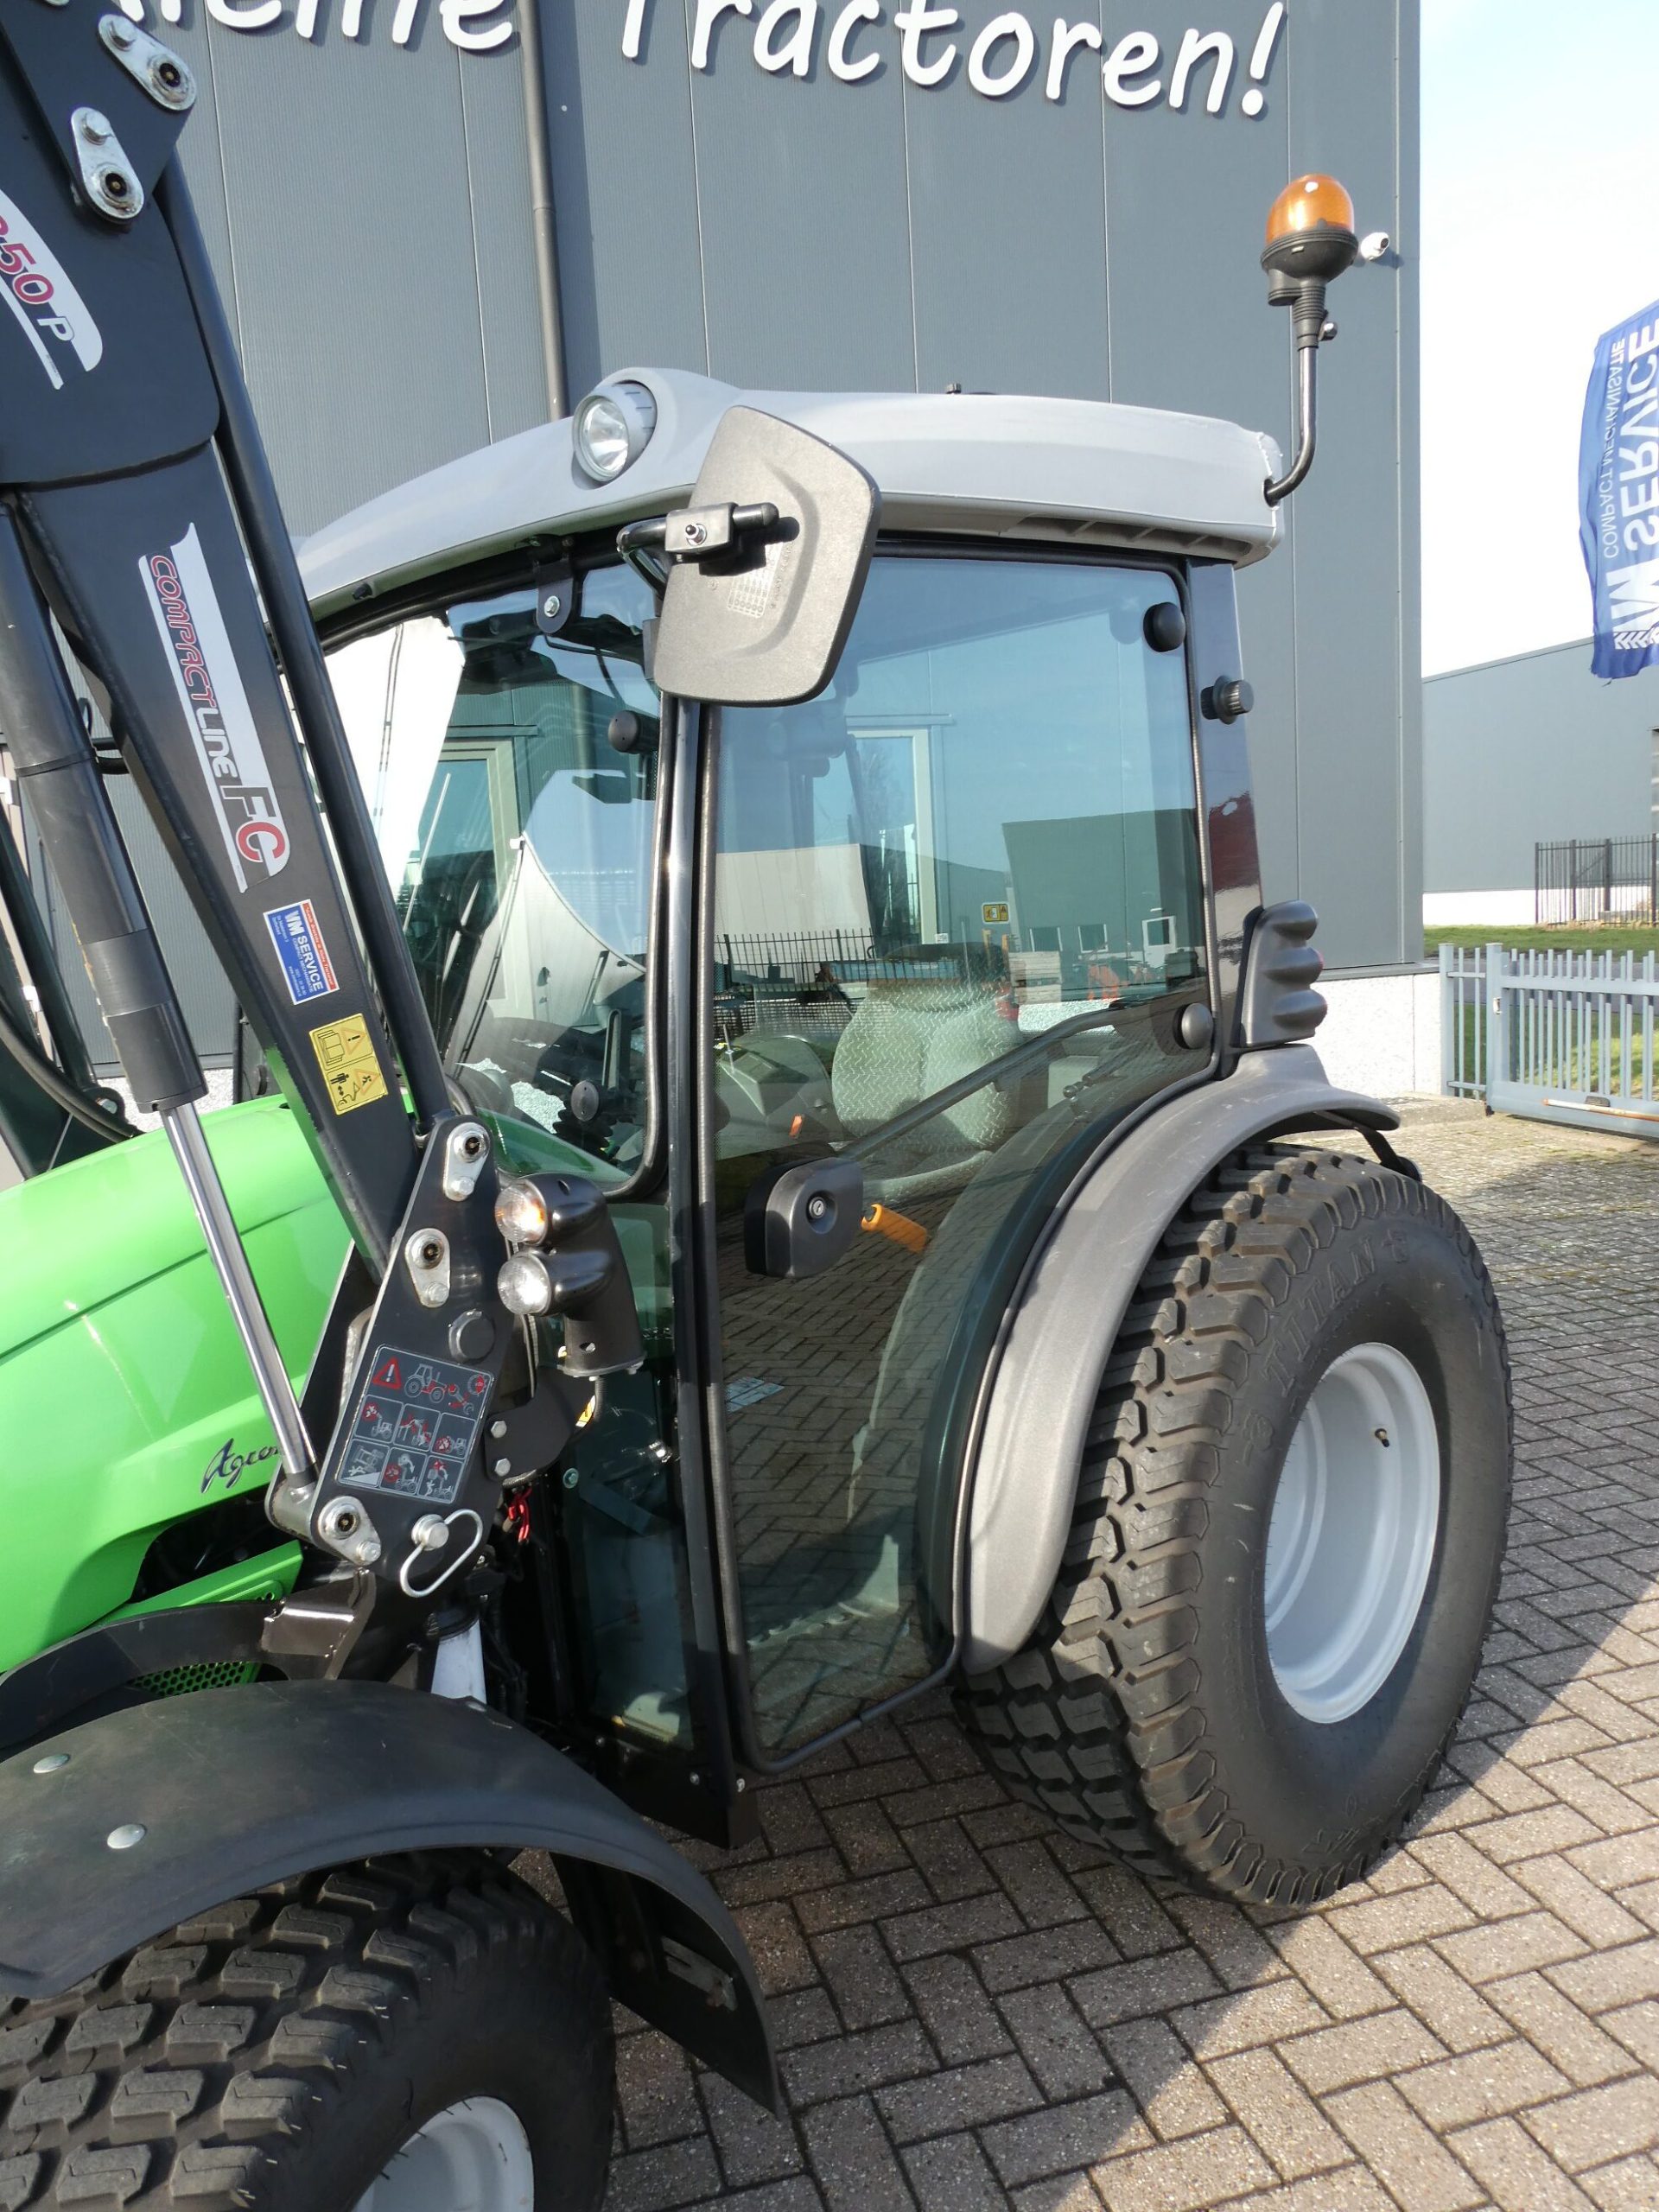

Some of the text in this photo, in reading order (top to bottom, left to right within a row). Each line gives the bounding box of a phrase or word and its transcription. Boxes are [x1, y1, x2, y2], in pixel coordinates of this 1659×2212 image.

[0, 214, 75, 341] 50 P
[284, 910, 305, 937] VM
[297, 935, 324, 992] SERVICE
[200, 1437, 278, 1494] Agro
